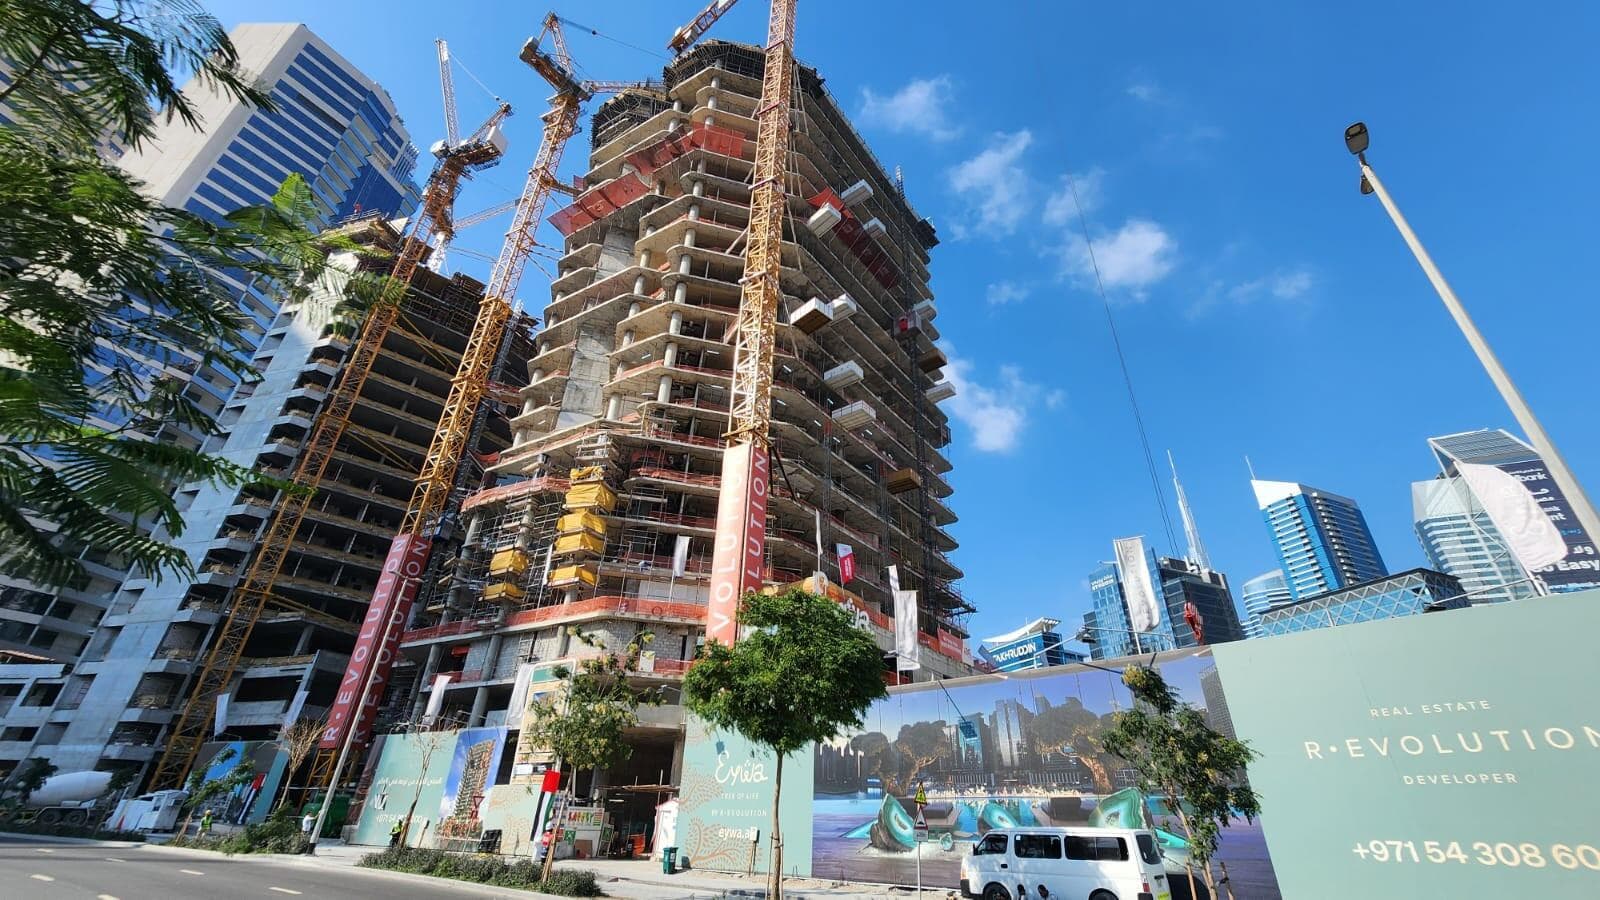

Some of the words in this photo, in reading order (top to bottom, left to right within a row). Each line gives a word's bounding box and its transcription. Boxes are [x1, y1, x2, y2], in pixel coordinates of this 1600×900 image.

[1370, 706, 1413, 719] REAL
[1422, 700, 1491, 714] ESTATE
[1403, 773, 1518, 785] DEVELOPER
[1352, 840, 1420, 863] +971
[1424, 841, 1468, 864] 54
[1473, 842, 1547, 868] 308
